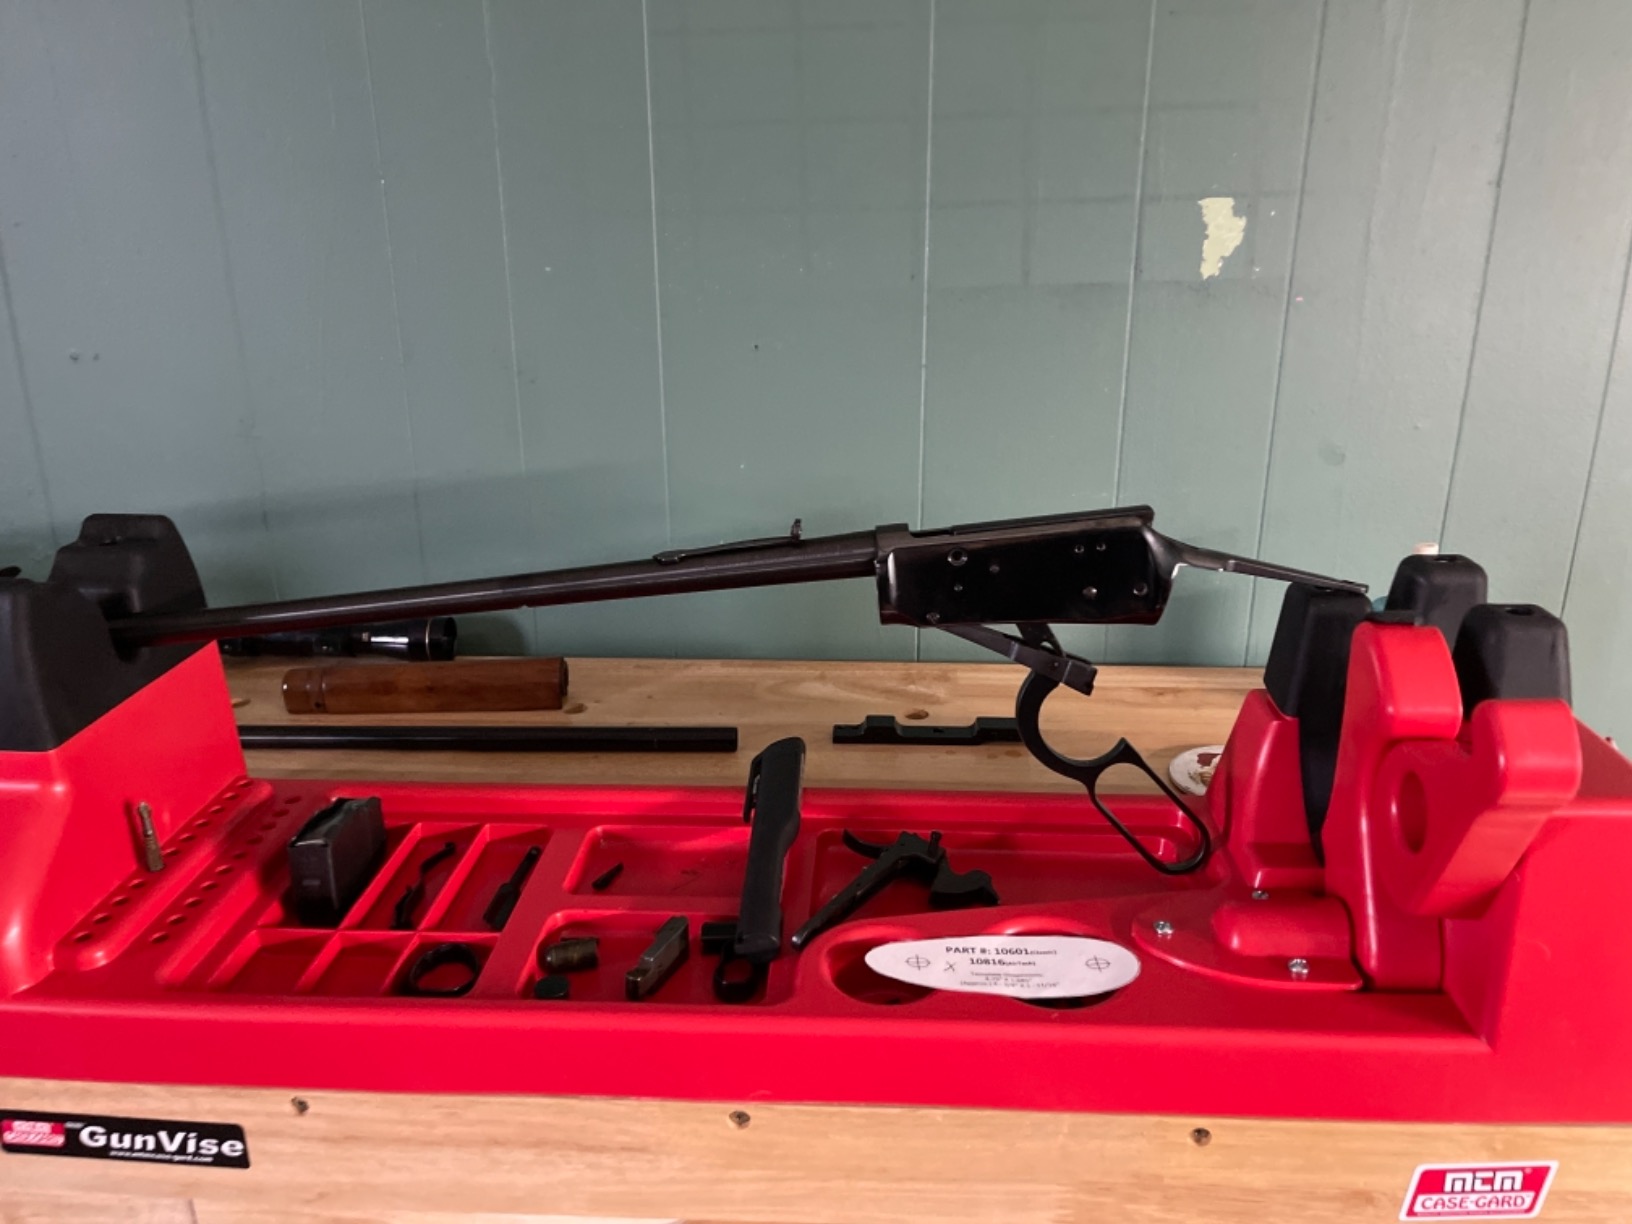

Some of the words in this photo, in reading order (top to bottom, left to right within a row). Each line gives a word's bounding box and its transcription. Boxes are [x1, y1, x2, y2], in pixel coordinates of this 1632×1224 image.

[945, 946, 976, 955] PART
[994, 947, 1030, 955] 10601
[970, 957, 1005, 966] 10816
[79, 1125, 244, 1156] GunVise
[1421, 1195, 1526, 1210] CASE-GARD
